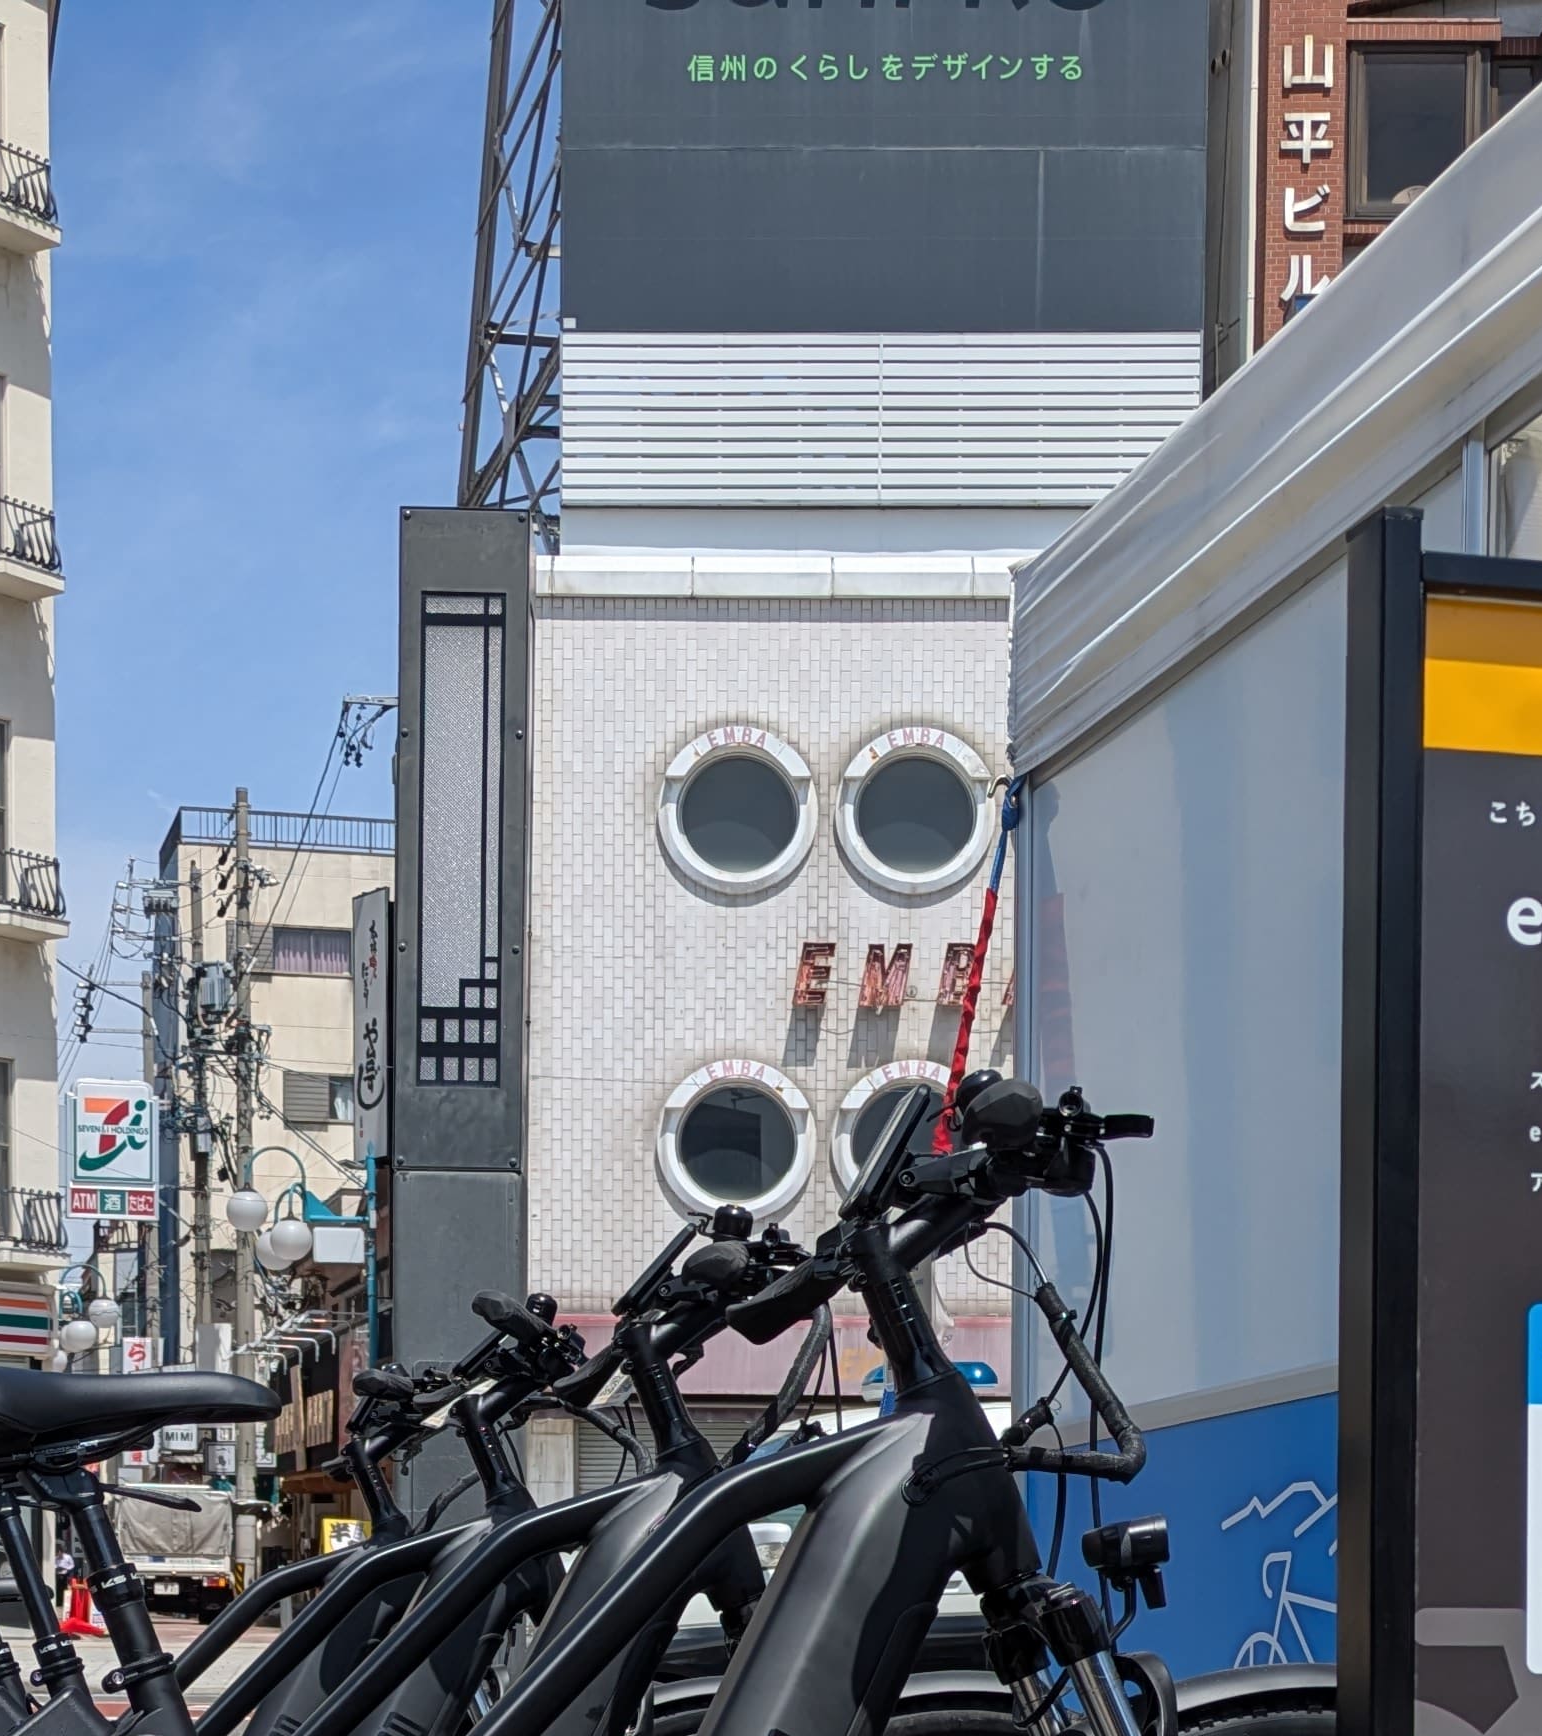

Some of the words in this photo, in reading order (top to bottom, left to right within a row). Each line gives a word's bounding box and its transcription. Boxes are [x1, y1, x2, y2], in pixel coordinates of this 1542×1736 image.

[687, 53, 1084, 82] 信州のくらしをデザインする
[1279, 34, 1334, 302] 山平ビル
[706, 727, 768, 750] EMBA
[886, 727, 946, 750] EMBA
[792, 942, 1015, 1007] EMB
[705, 1060, 766, 1081] EMBA
[882, 1060, 942, 1081] EMBA
[77, 1124, 101, 1134] SEVEN
[72, 1192, 97, 1209] ATM
[104, 1193, 122, 1211] 酒
[128, 1194, 154, 1212] たばこ
